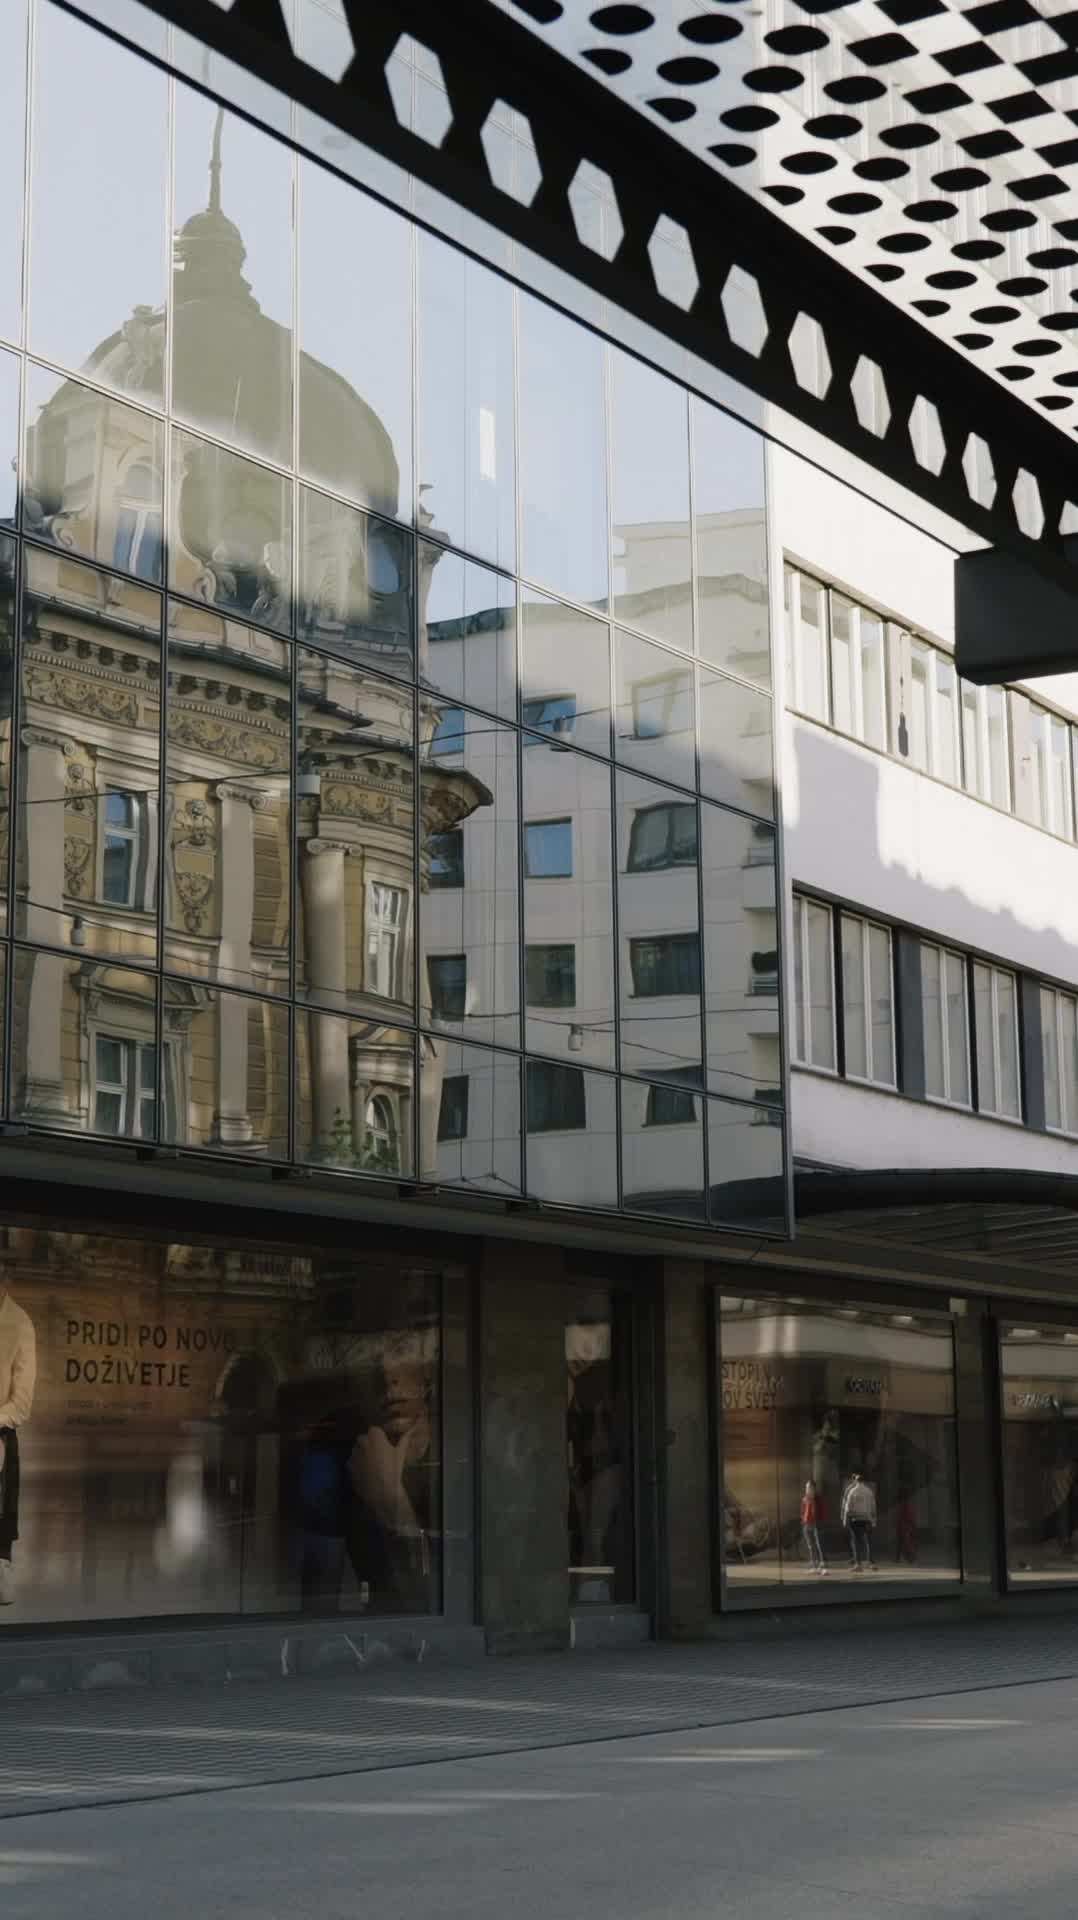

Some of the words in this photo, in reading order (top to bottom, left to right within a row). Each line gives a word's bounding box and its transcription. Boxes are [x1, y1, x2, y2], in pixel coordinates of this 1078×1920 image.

[66, 1320, 128, 1346] PRIDI
[139, 1325, 168, 1349] PO
[65, 1355, 191, 1387] DOŽIVETJE
